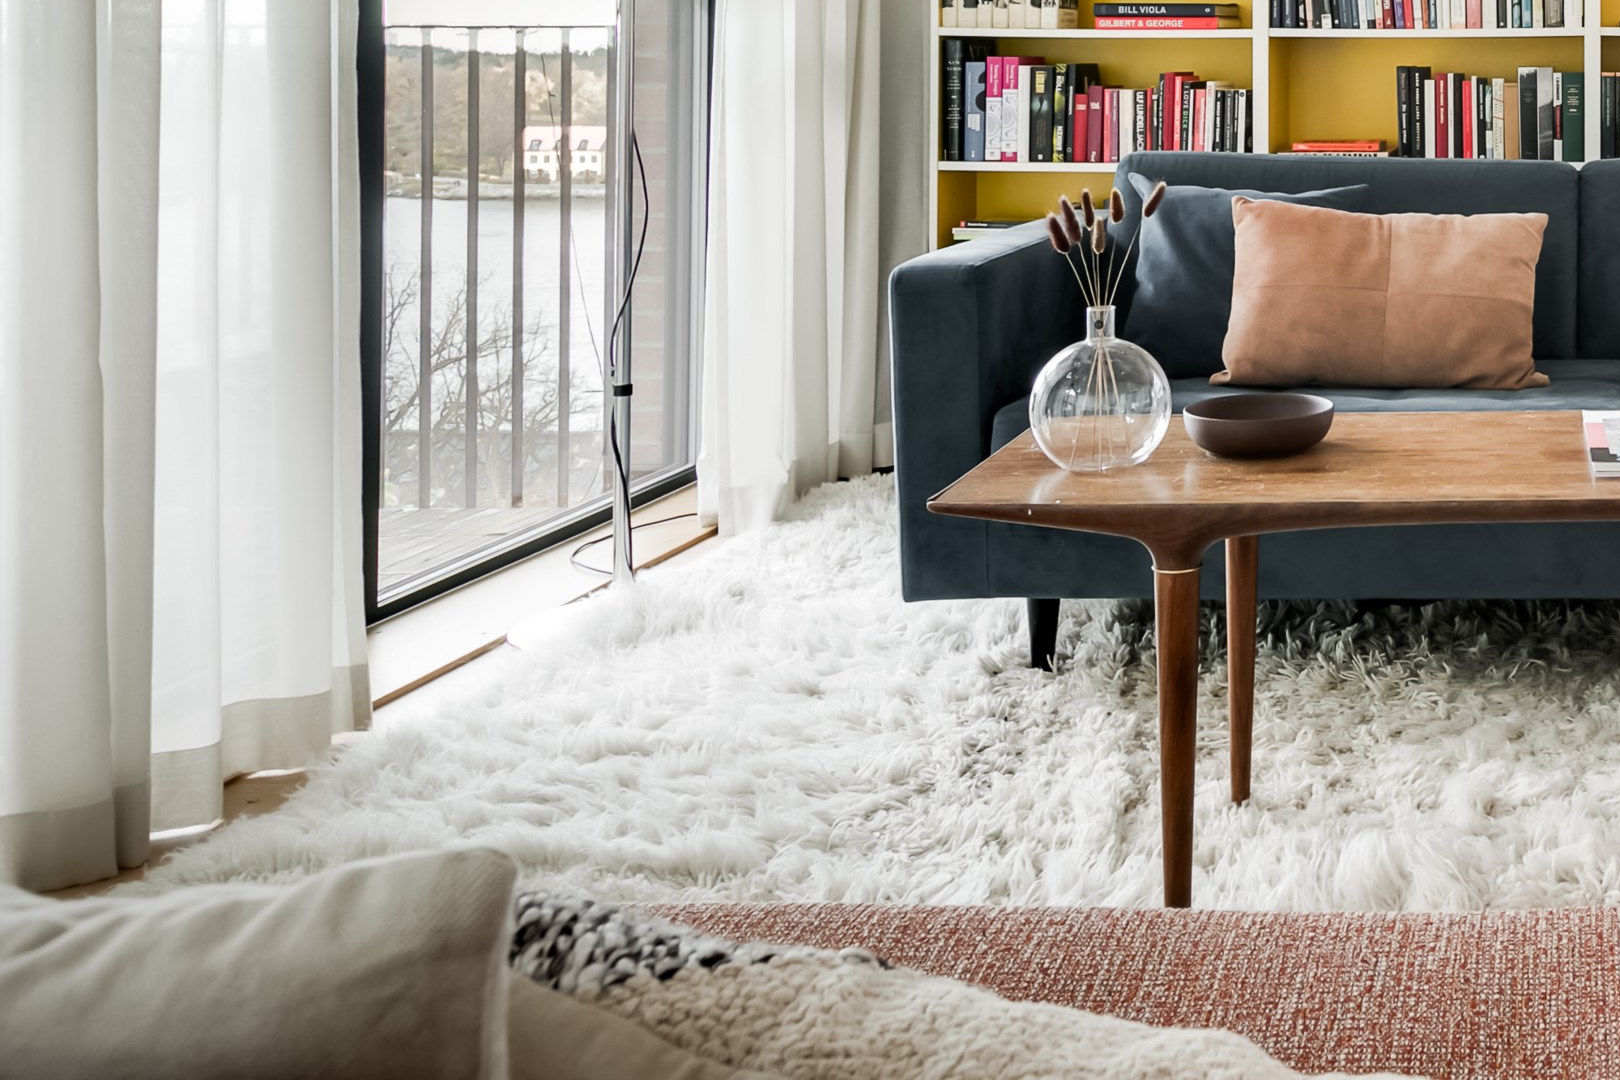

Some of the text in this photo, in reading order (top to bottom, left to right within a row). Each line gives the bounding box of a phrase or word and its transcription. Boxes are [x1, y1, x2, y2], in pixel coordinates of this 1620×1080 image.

[1118, 6, 1167, 14] BILL VIOLA
[1099, 19, 1137, 27] GILBERT
[1145, 19, 1183, 27] GEORGE
[1136, 91, 1145, 104] ULF
[1136, 104, 1144, 132] LUNDELL
